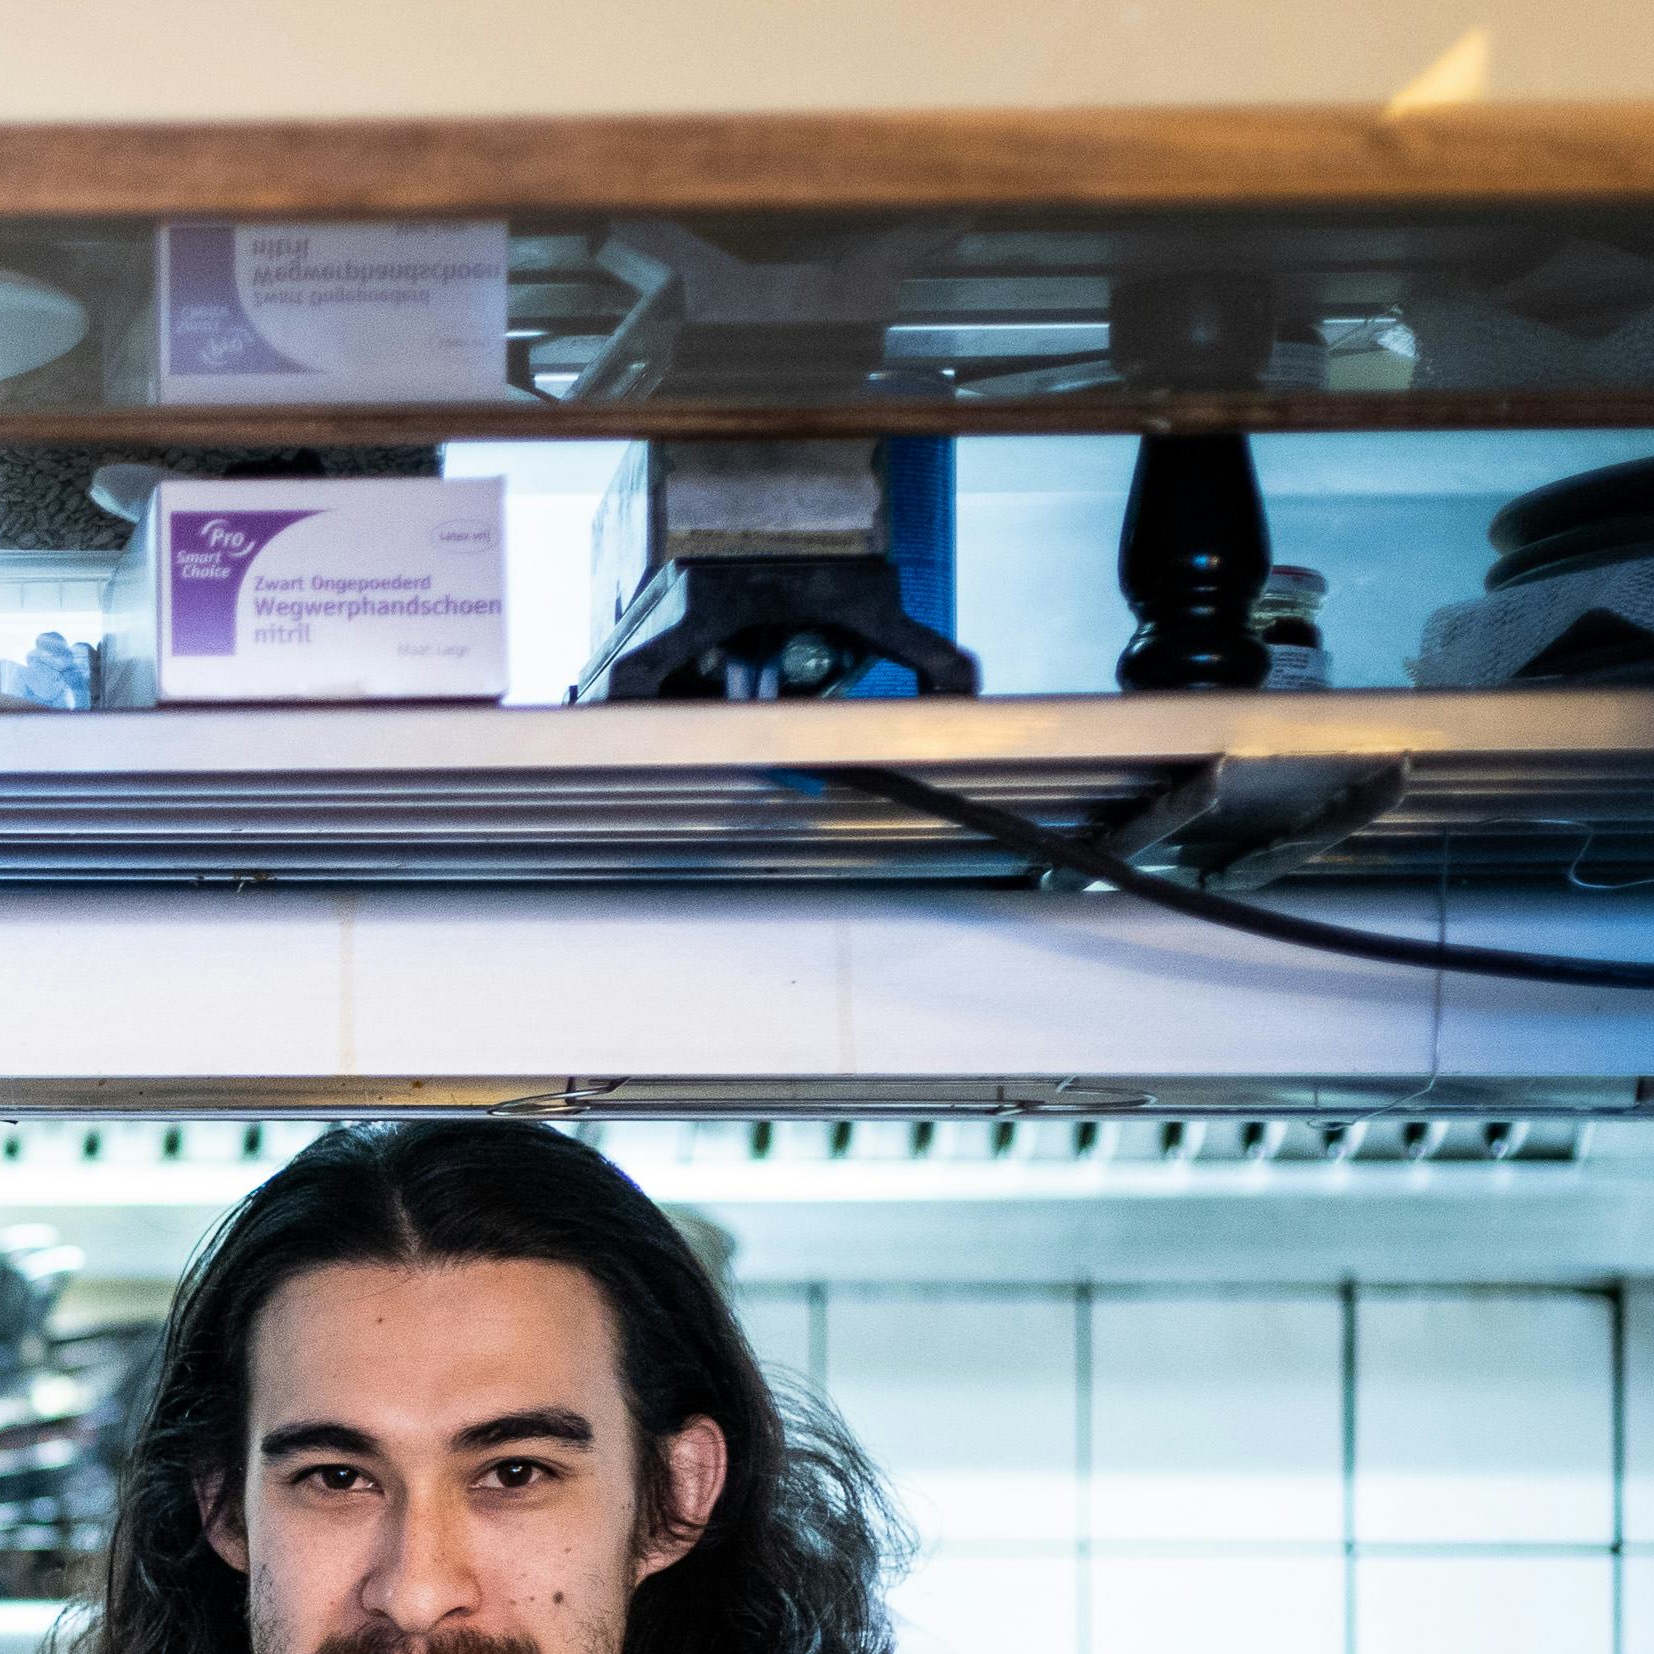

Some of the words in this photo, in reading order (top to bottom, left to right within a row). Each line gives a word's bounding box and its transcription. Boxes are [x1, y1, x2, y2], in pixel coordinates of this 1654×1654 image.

[210, 527, 245, 548] Pro
[177, 550, 222, 564] Smart
[182, 564, 231, 579] Choice
[254, 575, 304, 592] Zwart
[311, 575, 431, 593] Ongepoederd
[254, 594, 502, 621] Wegwerphandschoen
[254, 623, 310, 644] nitril
